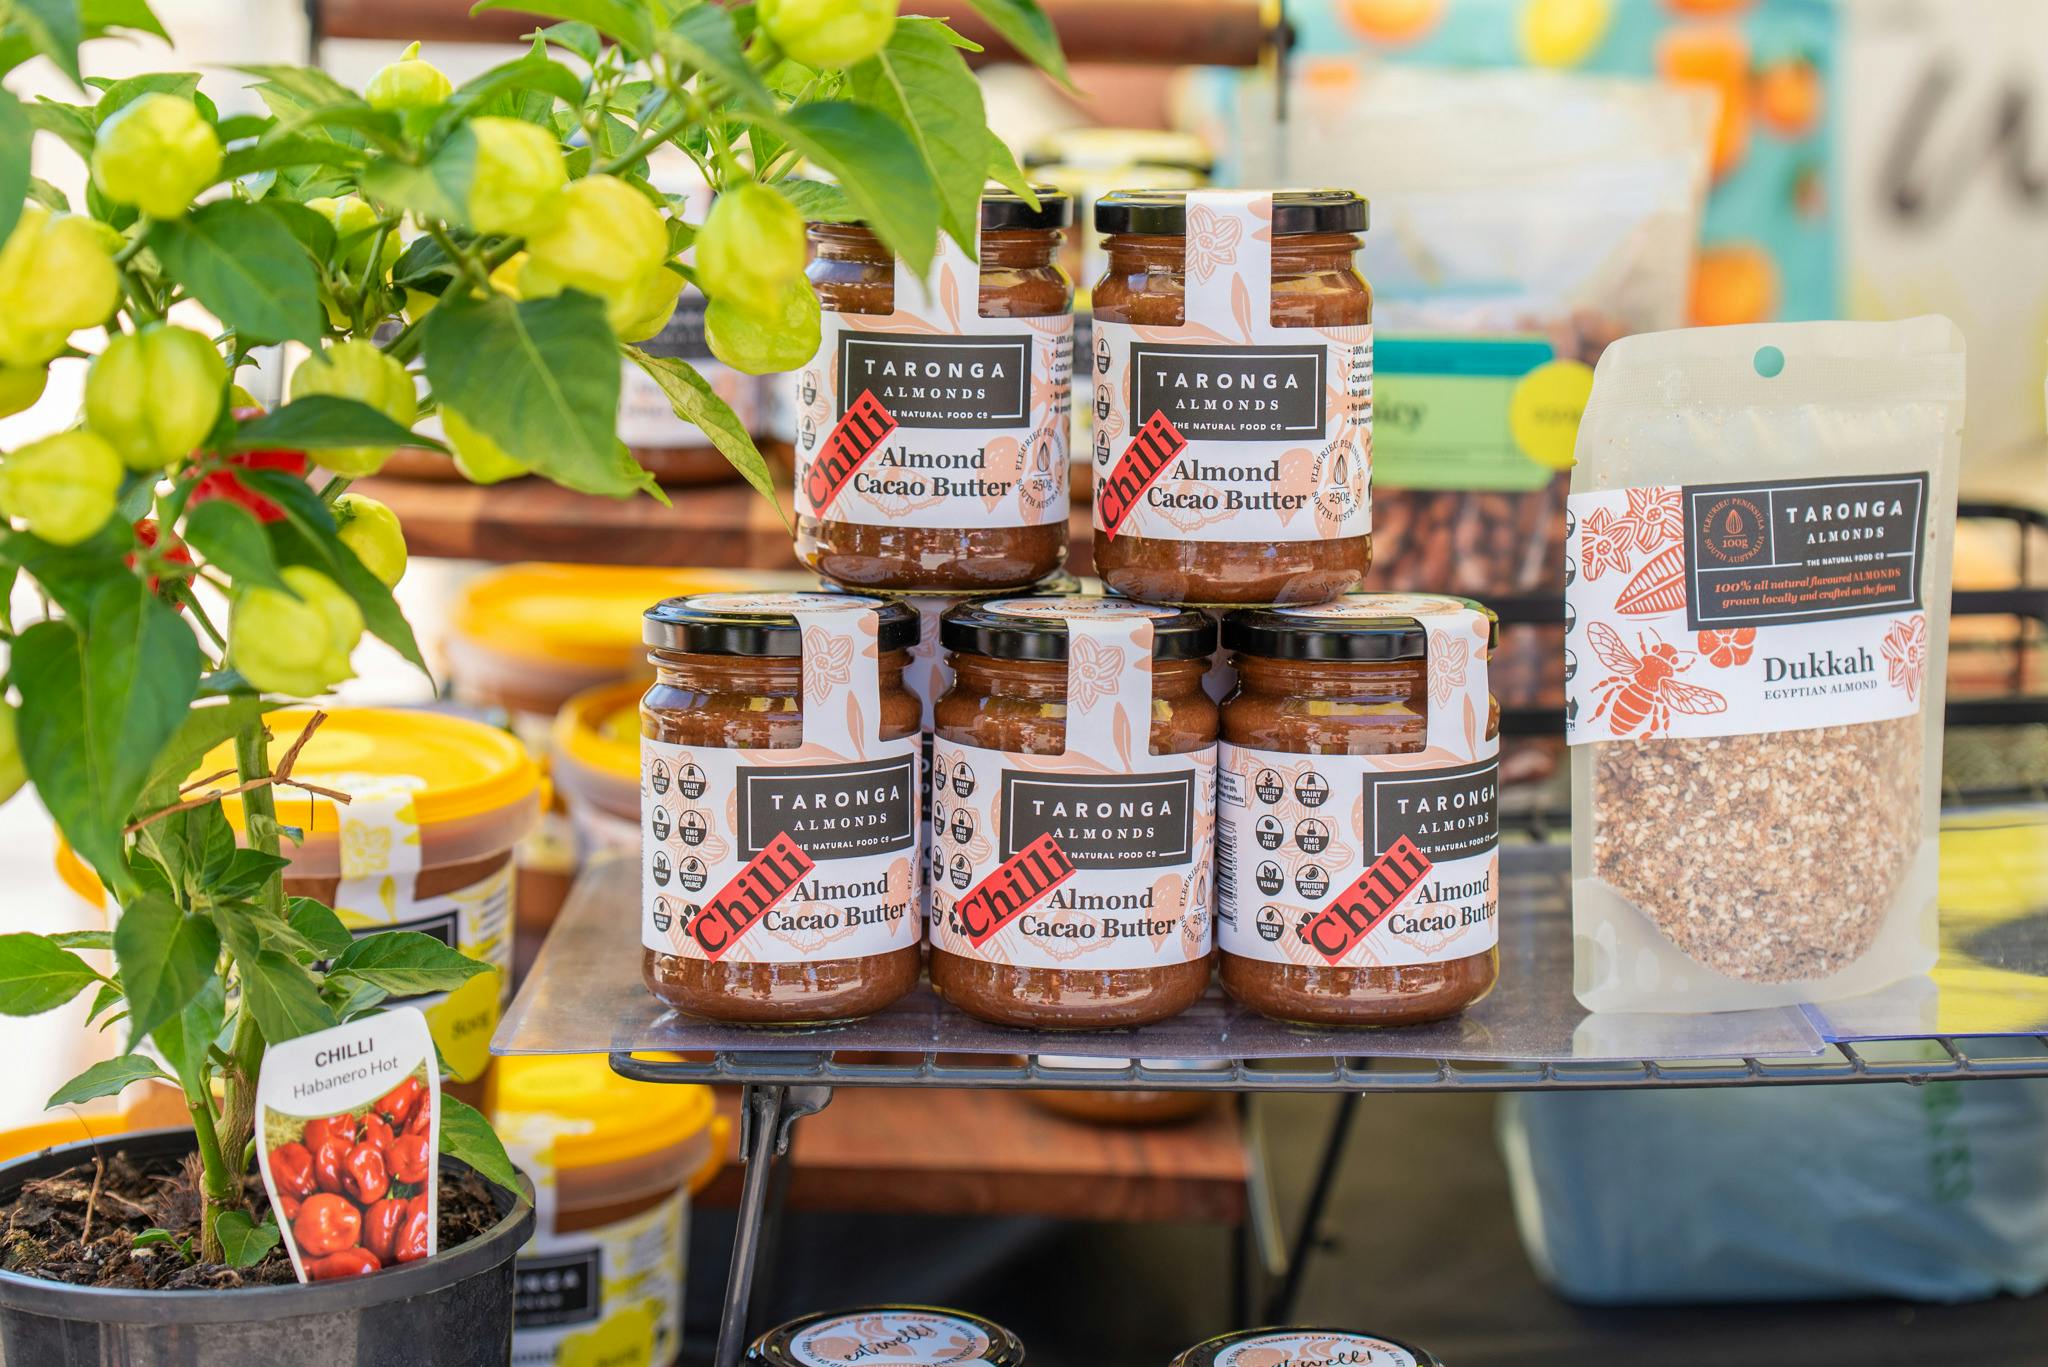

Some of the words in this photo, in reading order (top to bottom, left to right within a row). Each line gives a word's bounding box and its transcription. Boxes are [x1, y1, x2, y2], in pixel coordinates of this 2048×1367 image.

[864, 359, 1005, 379] TARONGA
[1156, 371, 1299, 389] TARONGA
[884, 386, 986, 399] ALMONDS
[1175, 398, 1279, 411] ALMONDS
[886, 409, 897, 417] HE
[901, 410, 944, 419] NATURAL
[947, 411, 973, 419] FOOD
[1173, 421, 1189, 430] THE
[1193, 422, 1236, 431] NATURAL
[1240, 423, 1266, 431] FOOD
[807, 401, 894, 509] Chilli
[879, 447, 986, 469] Almond
[1101, 419, 1183, 529] Chilli
[1171, 460, 1280, 482] Almond
[853, 473, 925, 496] Cacao
[932, 477, 1011, 497] Butter
[1147, 486, 1219, 509] Cacao
[1224, 490, 1307, 510] Butter
[1312, 491, 1333, 520] SOUTH
[1329, 492, 1350, 505] 250g
[1702, 499, 1730, 533] FLEURIEU
[1731, 496, 1765, 530] PENINSULA
[1785, 499, 1903, 523] TARONGA
[1722, 538, 1749, 549] 100g
[1806, 526, 1885, 545] ALMONDS
[1704, 538, 1727, 561] SOUTH
[1728, 535, 1765, 563] AUSTRALIA
[1806, 558, 1820, 566] THE
[1822, 556, 1853, 566] NATURAL
[1854, 554, 1874, 562] FOOD
[1714, 579, 1752, 593] 100%
[1754, 581, 1768, 591] all
[1771, 575, 1809, 589] natural
[1809, 571, 1852, 587] flavoured
[1853, 567, 1902, 583] ALMONDS
[1722, 595, 1760, 609] grown
[1762, 591, 1798, 606] locally
[1800, 590, 1818, 601] and
[1819, 587, 1851, 601] crafted
[1851, 589, 1862, 597] on
[1862, 585, 1875, 595] the
[1874, 583, 1896, 597] farm
[1763, 646, 1875, 683] Dukkah
[1764, 685, 1829, 700] EGYPTIAN
[1830, 679, 1878, 695] ALMOND
[683, 782, 700, 790] DAIRY
[684, 789, 699, 797] FREE
[955, 780, 969, 791] DAIRY
[956, 787, 968, 796] FREE
[1258, 785, 1280, 795] GLUTEN
[1301, 790, 1321, 798] DAIRY
[771, 785, 900, 810] TARONGA
[1261, 793, 1276, 802] FREE
[1303, 797, 1320, 805] FREE
[1397, 784, 1495, 815] TARONGA
[1032, 800, 1172, 818] TARONGA
[793, 812, 888, 832] ALMONDS
[1418, 811, 1490, 835] ALMONDS
[685, 828, 699, 836] GMO
[685, 835, 700, 843] FREE
[955, 833, 967, 842] FREE
[1053, 827, 1154, 840] ALMONDS
[1263, 833, 1275, 841] SOY
[1304, 837, 1320, 845] GMO
[797, 843, 809, 851] HE
[812, 840, 854, 851] NATURAL
[856, 837, 879, 847] FOOD
[1262, 839, 1276, 848] FREE
[1303, 843, 1320, 851] FREE
[1417, 845, 1432, 854] THE
[1435, 842, 1468, 853] NATURAL
[1469, 837, 1484, 848] FOOD
[1071, 851, 1114, 859] NATURAL
[1118, 851, 1144, 859] FOOD
[682, 874, 703, 883] PROTEIN
[684, 881, 702, 889] SOURCE
[791, 872, 889, 902] Almond
[1260, 880, 1279, 889] VEGAN
[1300, 881, 1325, 890] PROTEIN
[961, 839, 1073, 939] Chilli
[1301, 888, 1323, 897] SOURCE
[1415, 871, 1490, 905] Almond
[695, 843, 809, 953] Chilli
[1047, 887, 1154, 910] Almond
[1311, 843, 1429, 957] Chilli
[762, 909, 839, 931] Cacao
[844, 902, 906, 927] Butter
[1387, 913, 1456, 935] Cacao
[1461, 900, 1497, 926] Butter
[1018, 915, 1095, 939] Cacao
[1102, 918, 1176, 938] Butter
[1262, 931, 1278, 940] FIBRE
[314, 1038, 374, 1068] CHILLI
[293, 1066, 367, 1100] Habanero
[370, 1056, 399, 1077] Hot
